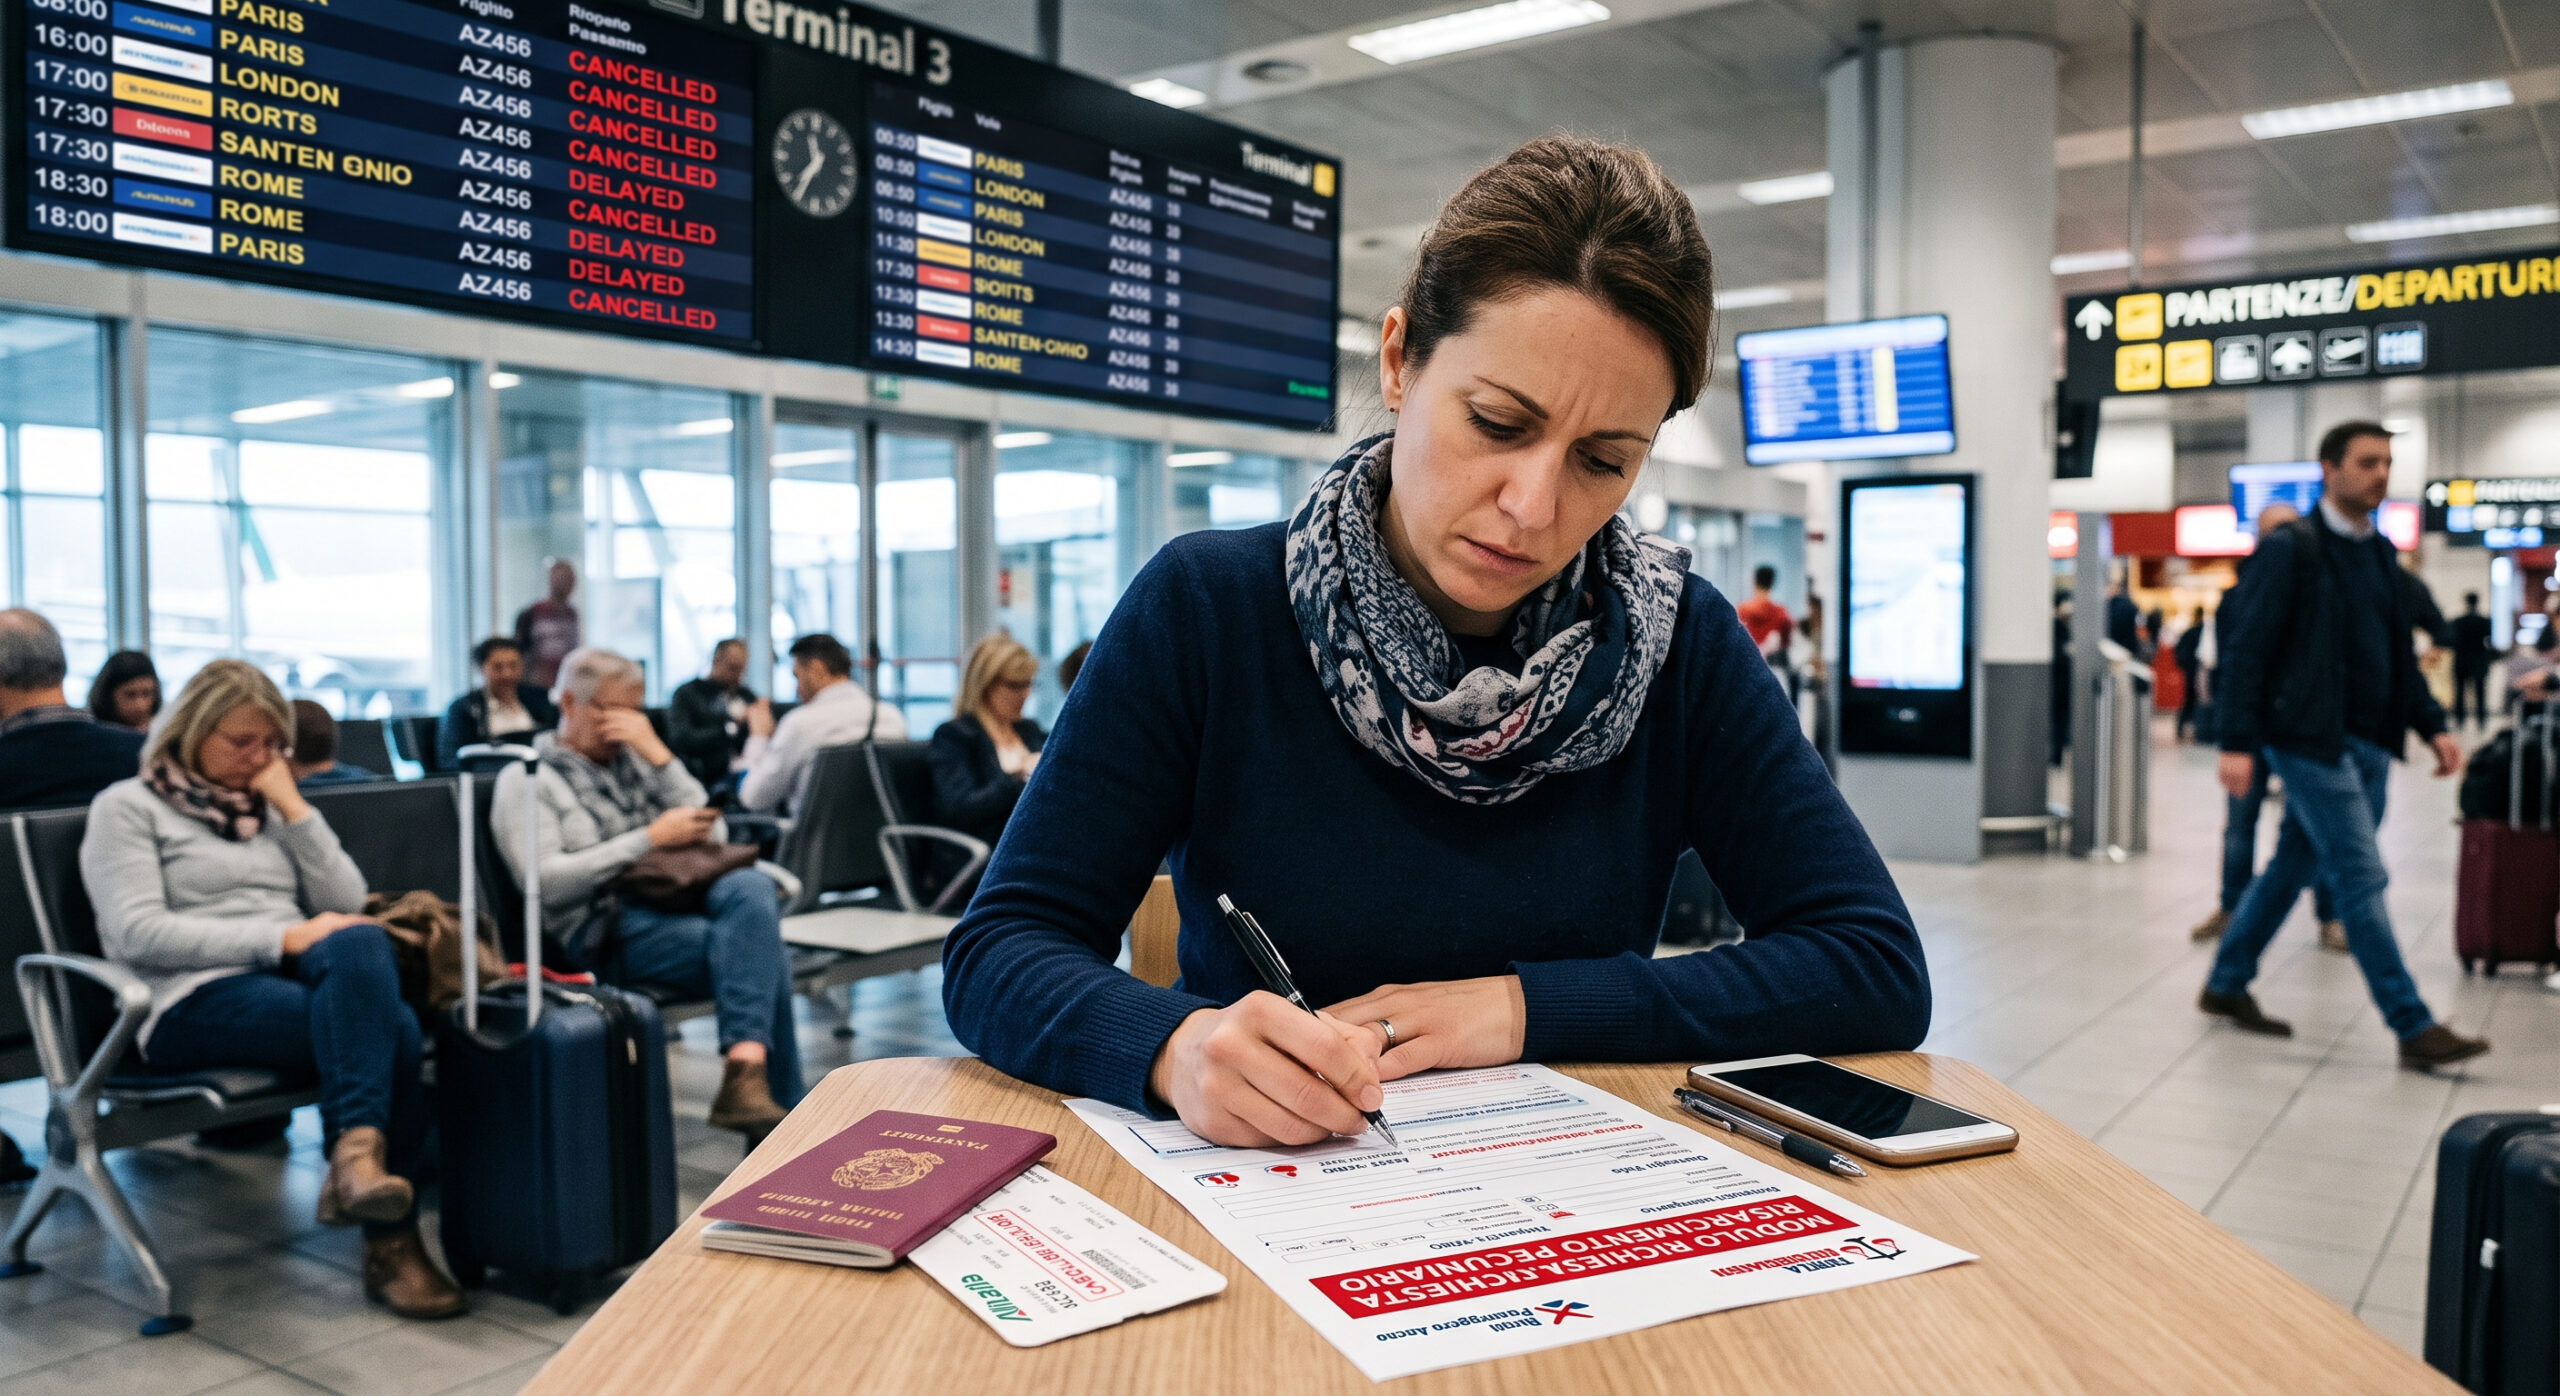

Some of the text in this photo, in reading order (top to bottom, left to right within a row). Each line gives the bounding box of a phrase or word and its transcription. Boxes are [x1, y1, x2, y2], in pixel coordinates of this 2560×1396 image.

[219, 0, 304, 33] PARIS
[459, 55, 531, 88] AZ456
[568, 80, 716, 132] CANCELLED
[459, 24, 716, 104] AZ456 CANCELLED
[926, 38, 951, 85] 3
[34, 24, 108, 56] 16:00
[219, 63, 339, 107] LONDON
[459, 118, 531, 148] AZ456
[568, 140, 716, 189] CANCELLED
[219, 30, 305, 66] PARIS
[459, 86, 531, 118] AZ456
[568, 110, 716, 161] CANCELLED
[34, 60, 684, 210] 17:00 RORTS AZ456 DELAYED
[34, 96, 108, 127] 17:30
[219, 131, 334, 171] SANTEN
[459, 180, 531, 209] AZ456
[568, 200, 716, 245] CANCELLED
[974, 153, 1024, 179] PARIS
[34, 132, 108, 163] 17:30
[219, 165, 304, 199] ROME
[459, 211, 531, 241] AZ456
[568, 229, 684, 268] DELAYED
[974, 178, 1045, 209] LONDON
[974, 202, 1024, 228] PARIS
[34, 167, 108, 198] 18:30
[219, 198, 304, 232] ROME
[459, 242, 531, 271] AZ456
[568, 259, 684, 296] DELAYED
[974, 228, 1045, 256] LONDON
[34, 204, 108, 234] 18:00
[219, 232, 305, 265] PARIS
[459, 273, 531, 301] AZ456
[568, 289, 716, 330] CANCELLED
[974, 253, 1023, 277] ROME
[974, 302, 1023, 325] ROME
[974, 351, 1022, 374] ROME
[1562, 1201, 1804, 1253] RISARCIMENTO
[1694, 1215, 1834, 1247] MODULO
[1340, 1245, 1557, 1292] PECUNIARIO
